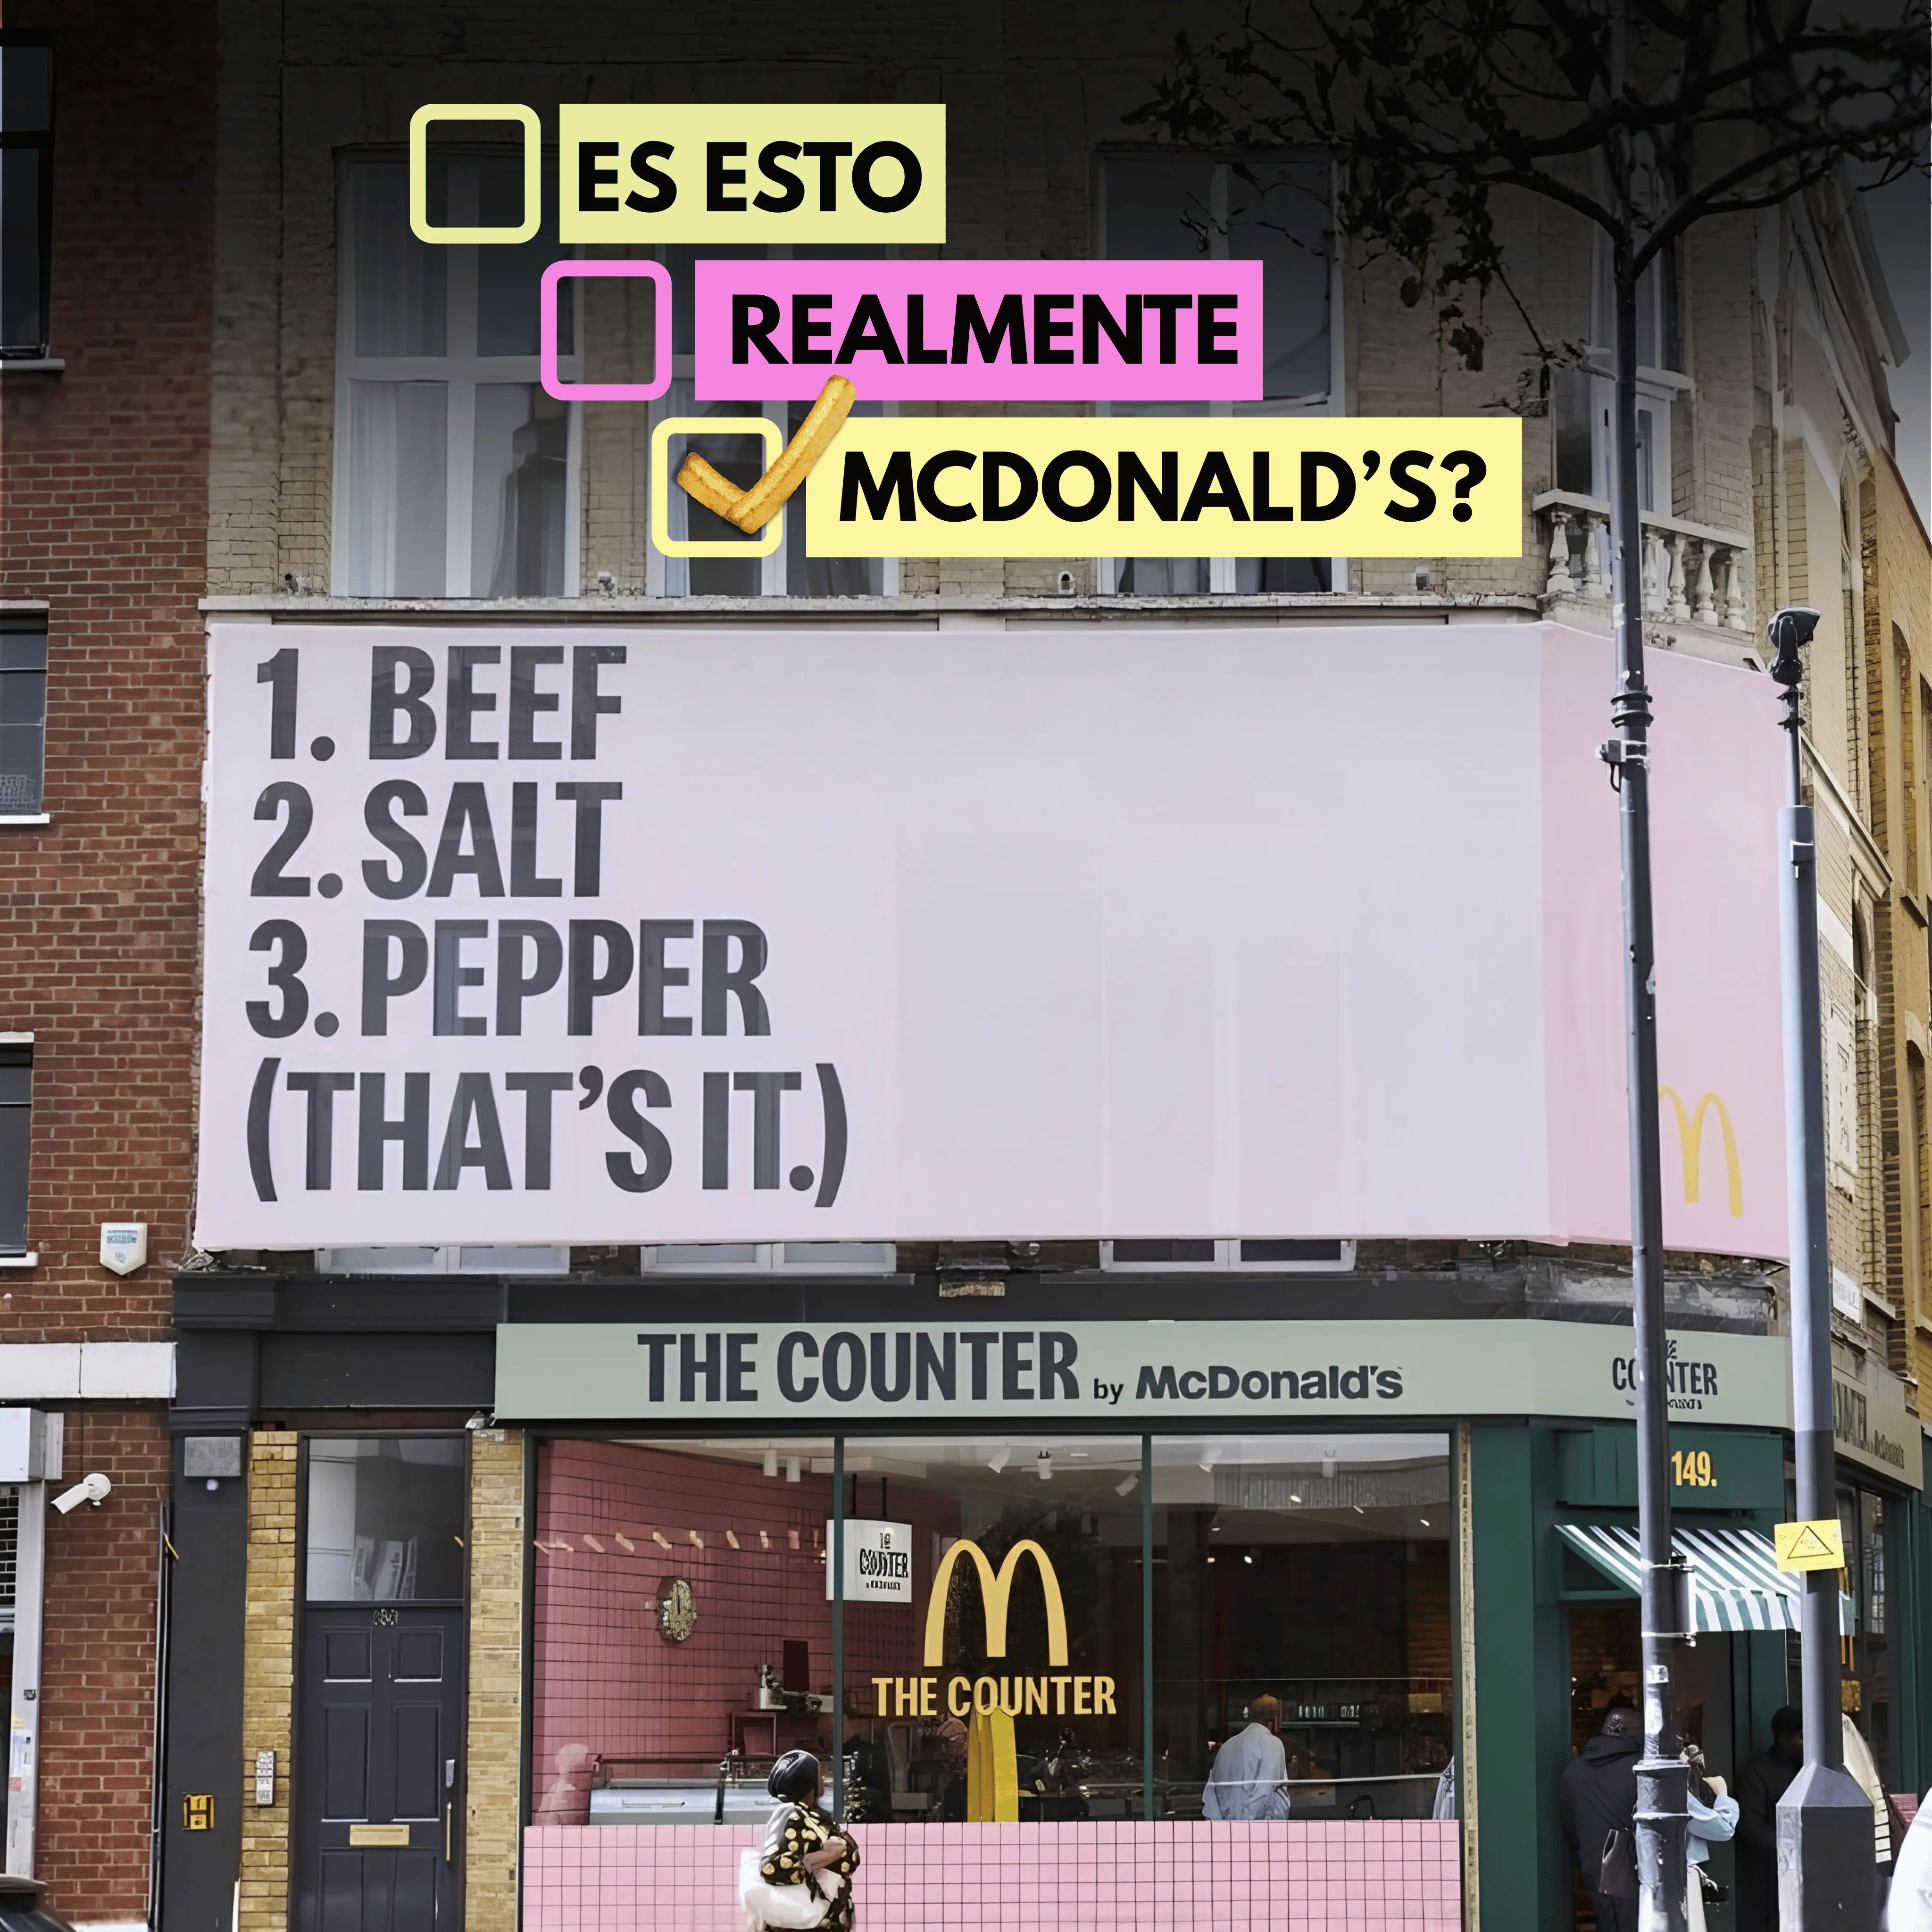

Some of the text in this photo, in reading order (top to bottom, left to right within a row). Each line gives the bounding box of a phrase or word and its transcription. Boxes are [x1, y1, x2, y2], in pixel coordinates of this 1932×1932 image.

[257, 645, 627, 762] 1. BEEF
[250, 779, 623, 900] 2. SALT
[245, 919, 771, 1039] 3. PEPPER
[247, 1057, 848, 1208] (THAT’S IT.)
[637, 1331, 1403, 1405] THE COUNTER by McDonald's
[1612, 1357, 1718, 1395] CONTER
[1671, 1451, 1717, 1487] 149.
[872, 1676, 1116, 1717] THE COUNTER
